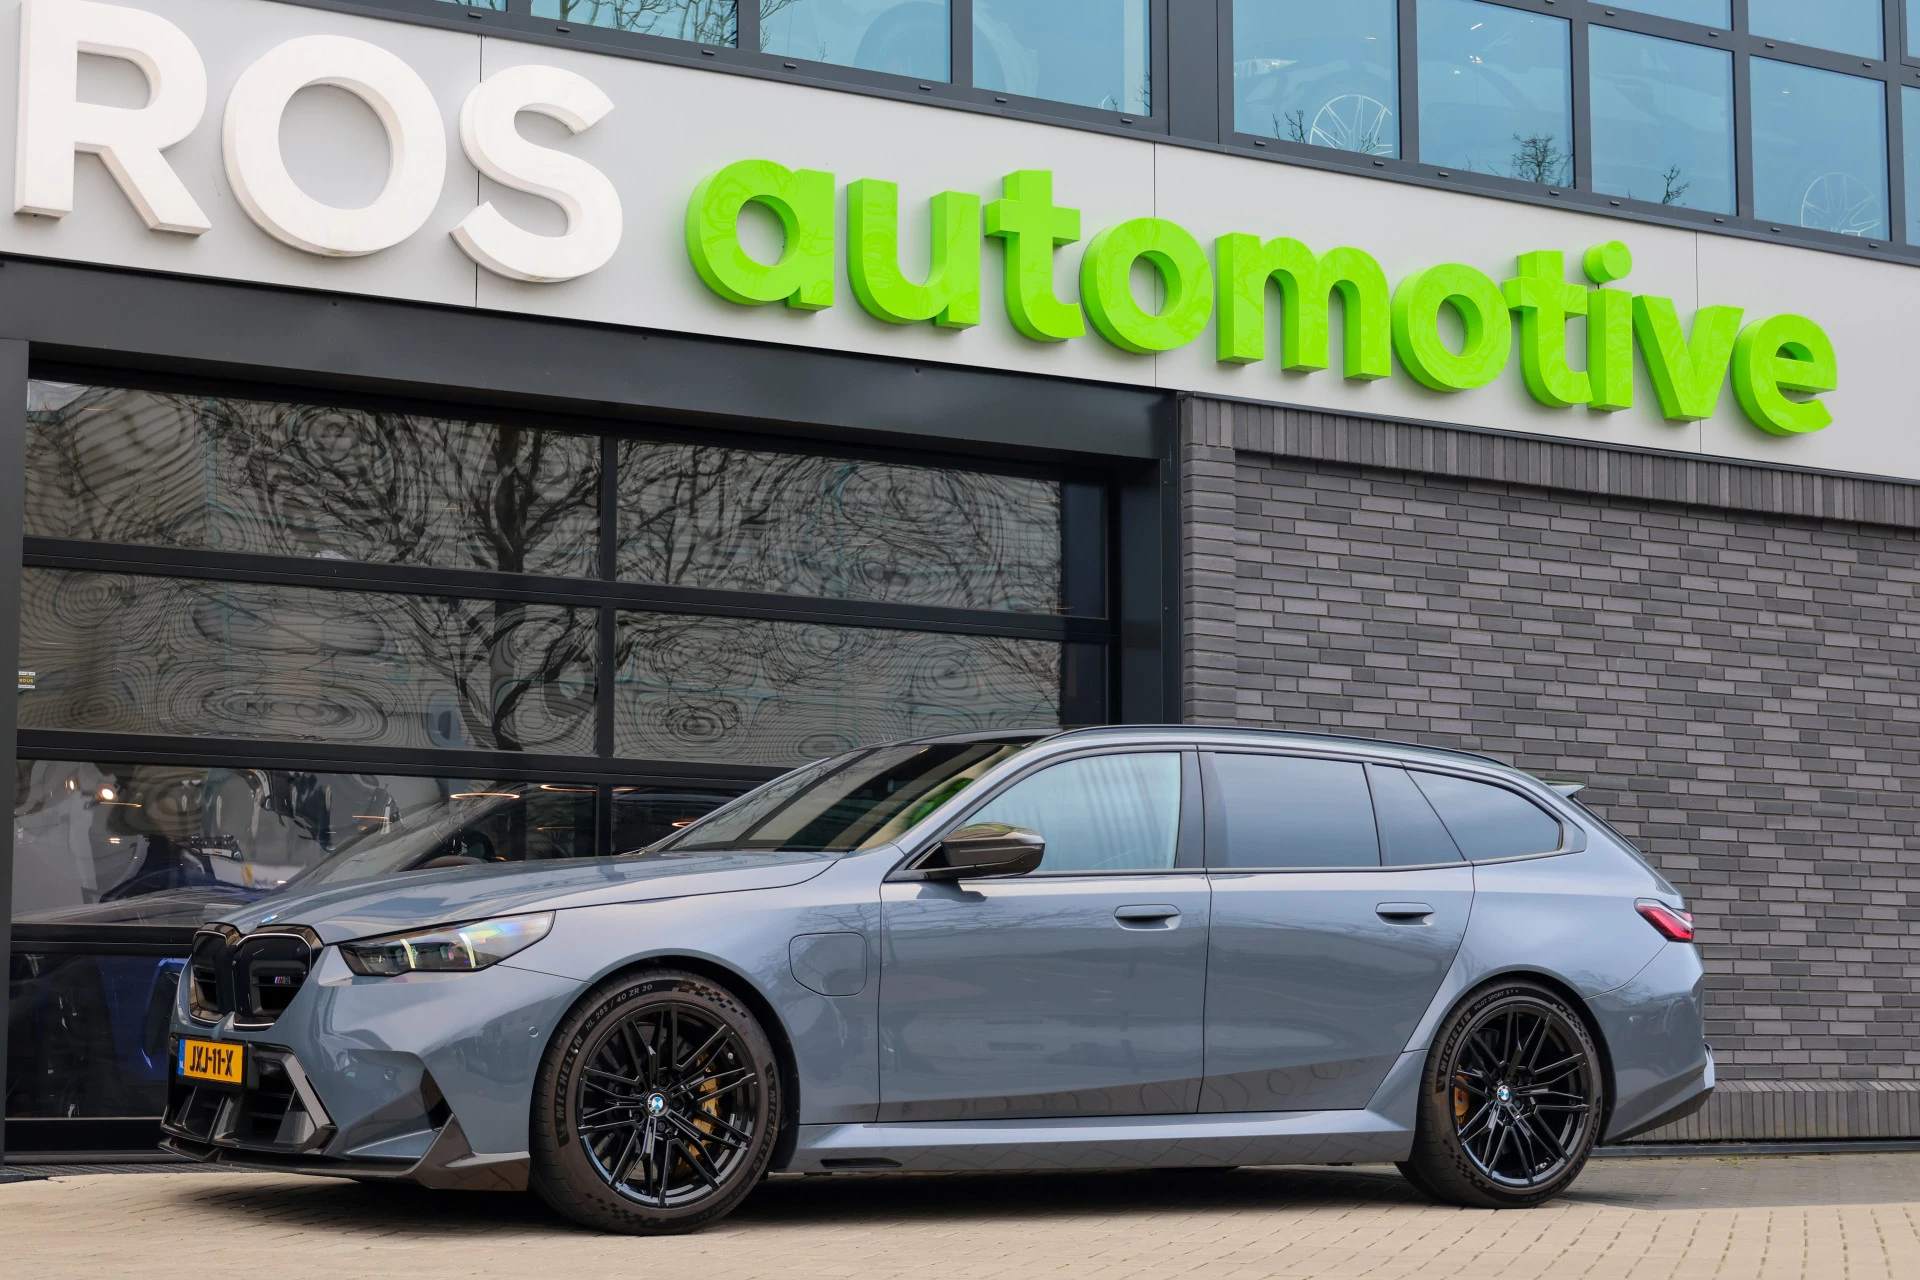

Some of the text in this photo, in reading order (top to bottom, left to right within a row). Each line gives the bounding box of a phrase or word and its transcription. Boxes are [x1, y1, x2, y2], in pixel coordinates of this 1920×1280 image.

[14, 0, 1836, 436] ROS automotive
[189, 1045, 234, 1077] JXJ-11-X
[556, 1035, 583, 1119] MICHELIN
[585, 1019, 595, 1031] HL
[595, 1005, 608, 1020] 285
[616, 993, 627, 1003] 40
[628, 987, 640, 997] ZR
[642, 983, 653, 992] 20
[1440, 1011, 1472, 1072] MICHELIN
[1487, 991, 1504, 1002] SPORT
